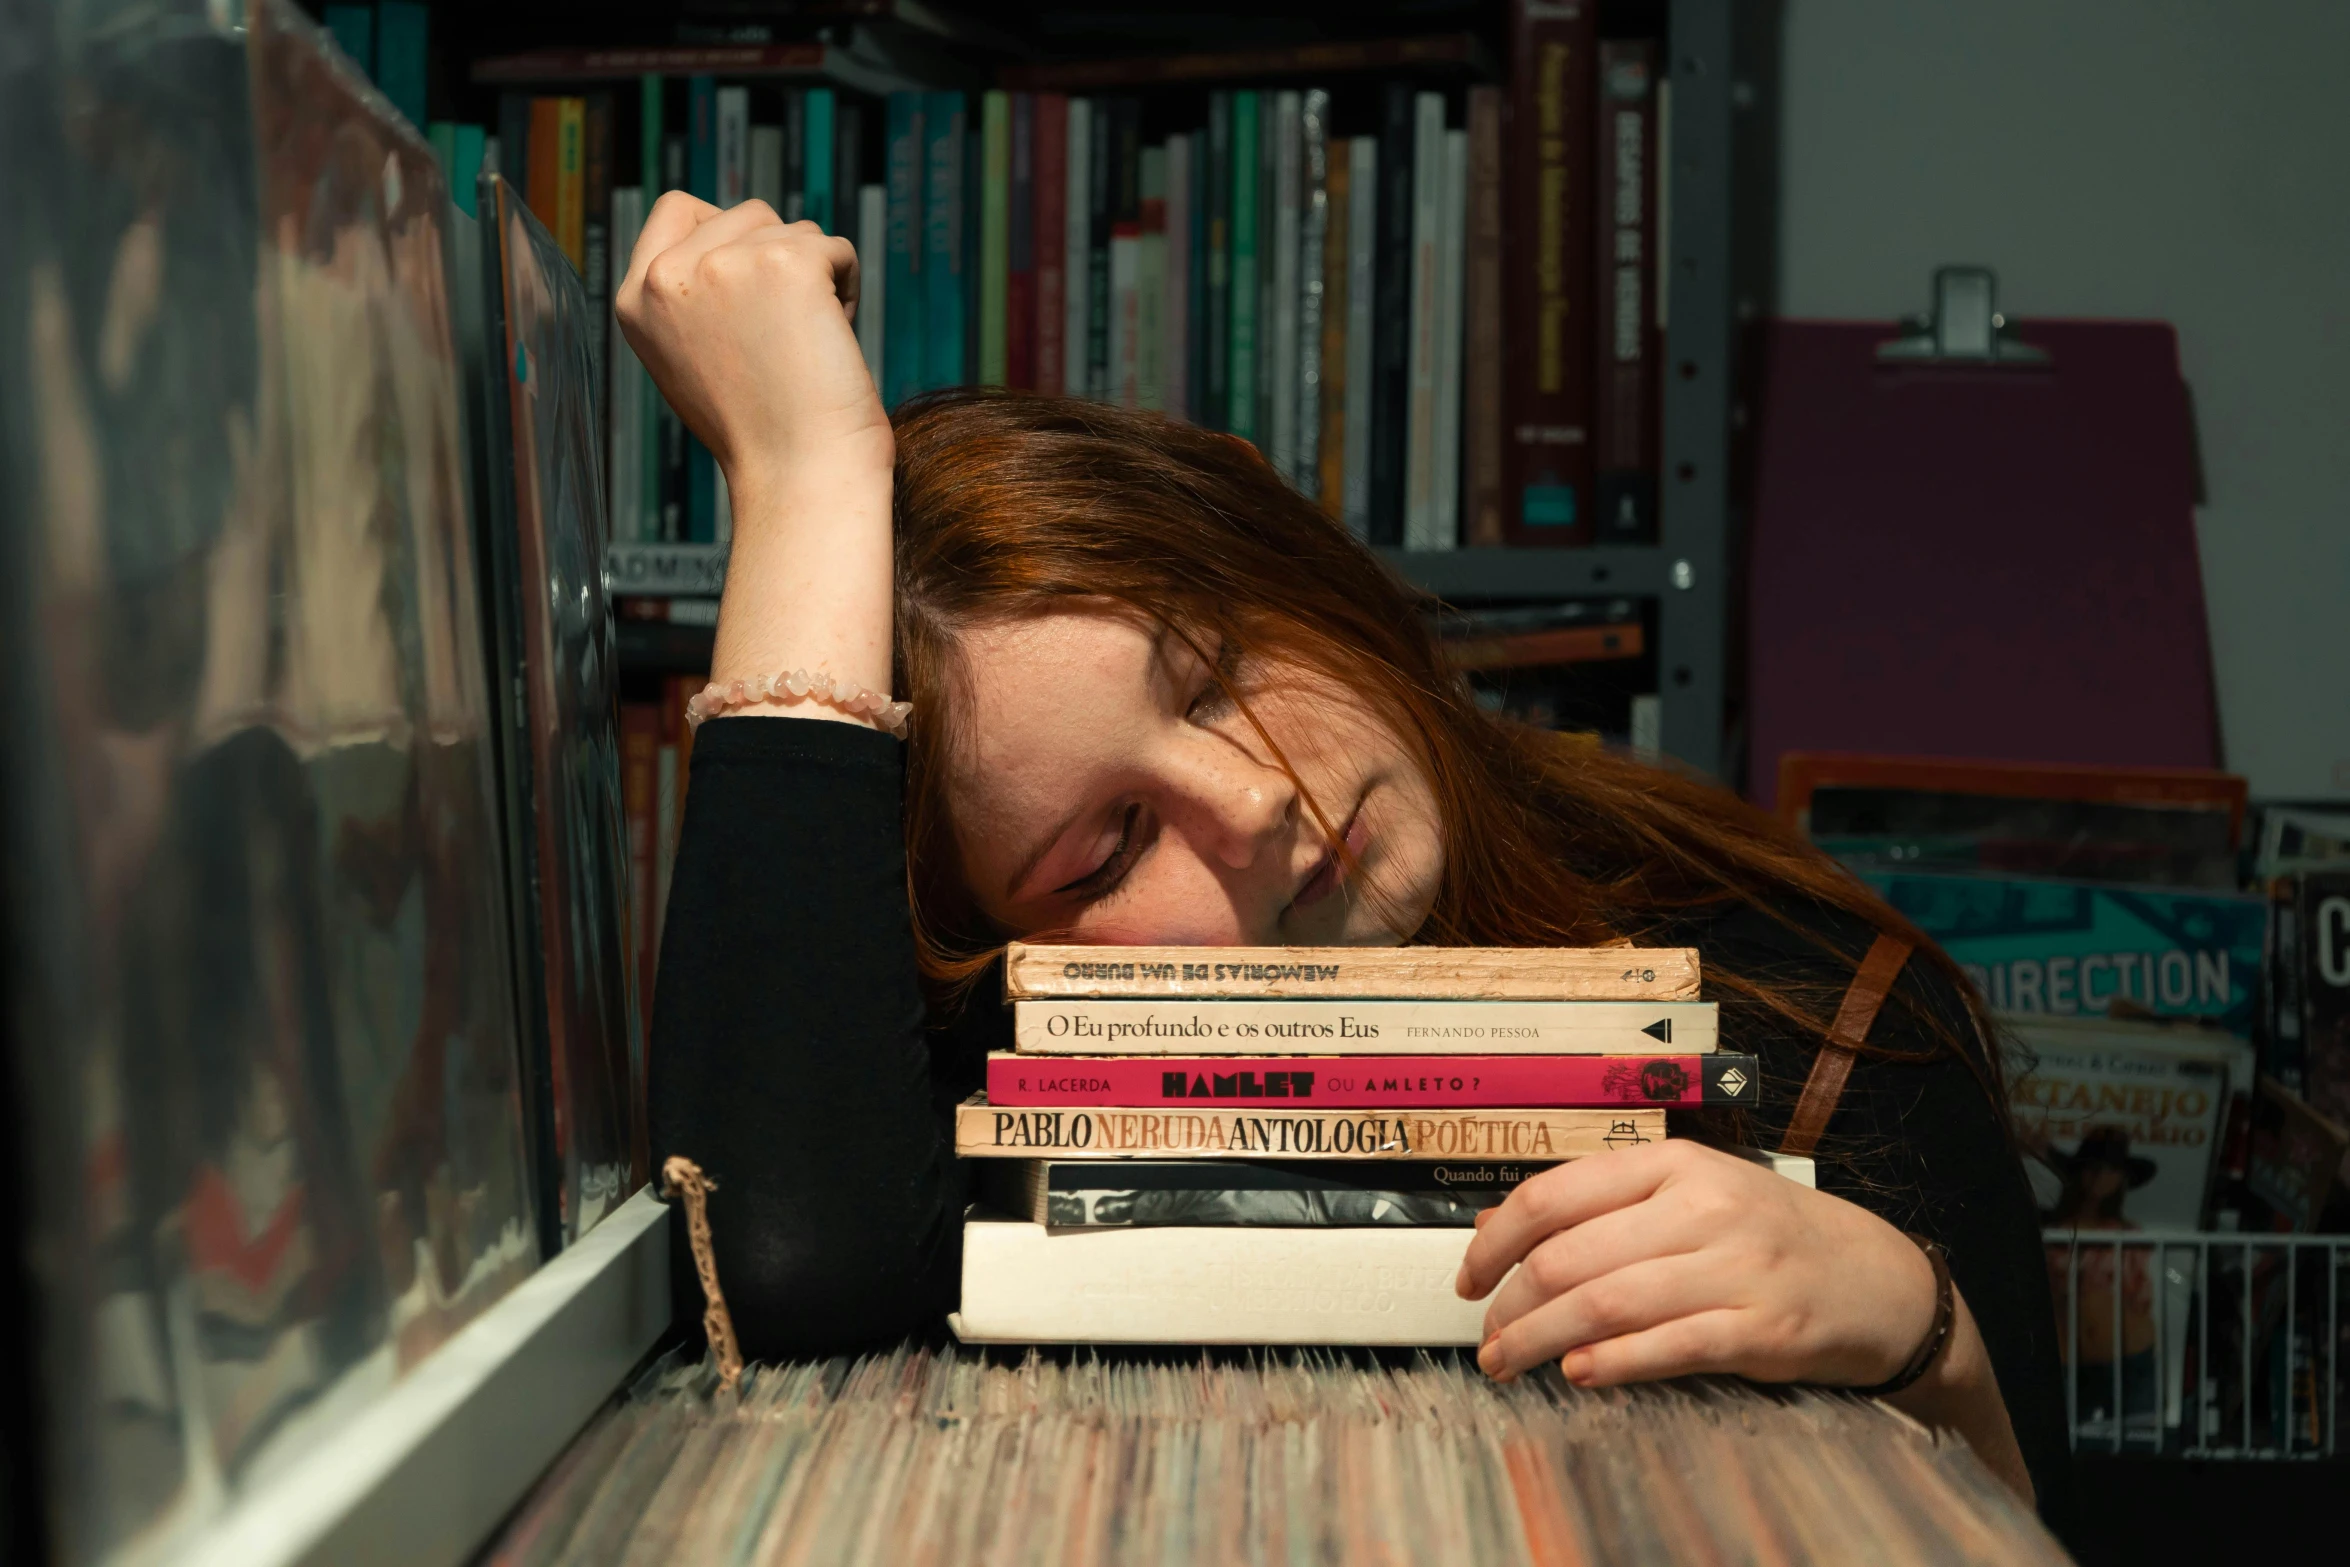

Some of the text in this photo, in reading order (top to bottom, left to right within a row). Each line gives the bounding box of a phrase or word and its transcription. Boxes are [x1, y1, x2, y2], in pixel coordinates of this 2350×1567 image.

[1063, 963, 1339, 986] MEMÓRIAS DE UM BURRO
[1046, 1014, 1380, 1042] O Eu profundo e os outros Eus
[1406, 1026, 1541, 1039] FERNANDO PESSOA
[1018, 1078, 1112, 1093] R. LACERDA
[1162, 1071, 1315, 1098] HAMLET
[1327, 1077, 1356, 1092] OU
[992, 1111, 1556, 1155] PABLO NERUDA ANTOLOGIA POÉTICA
[1433, 1166, 1495, 1186] Quando
[1500, 1166, 1520, 1182] fui
